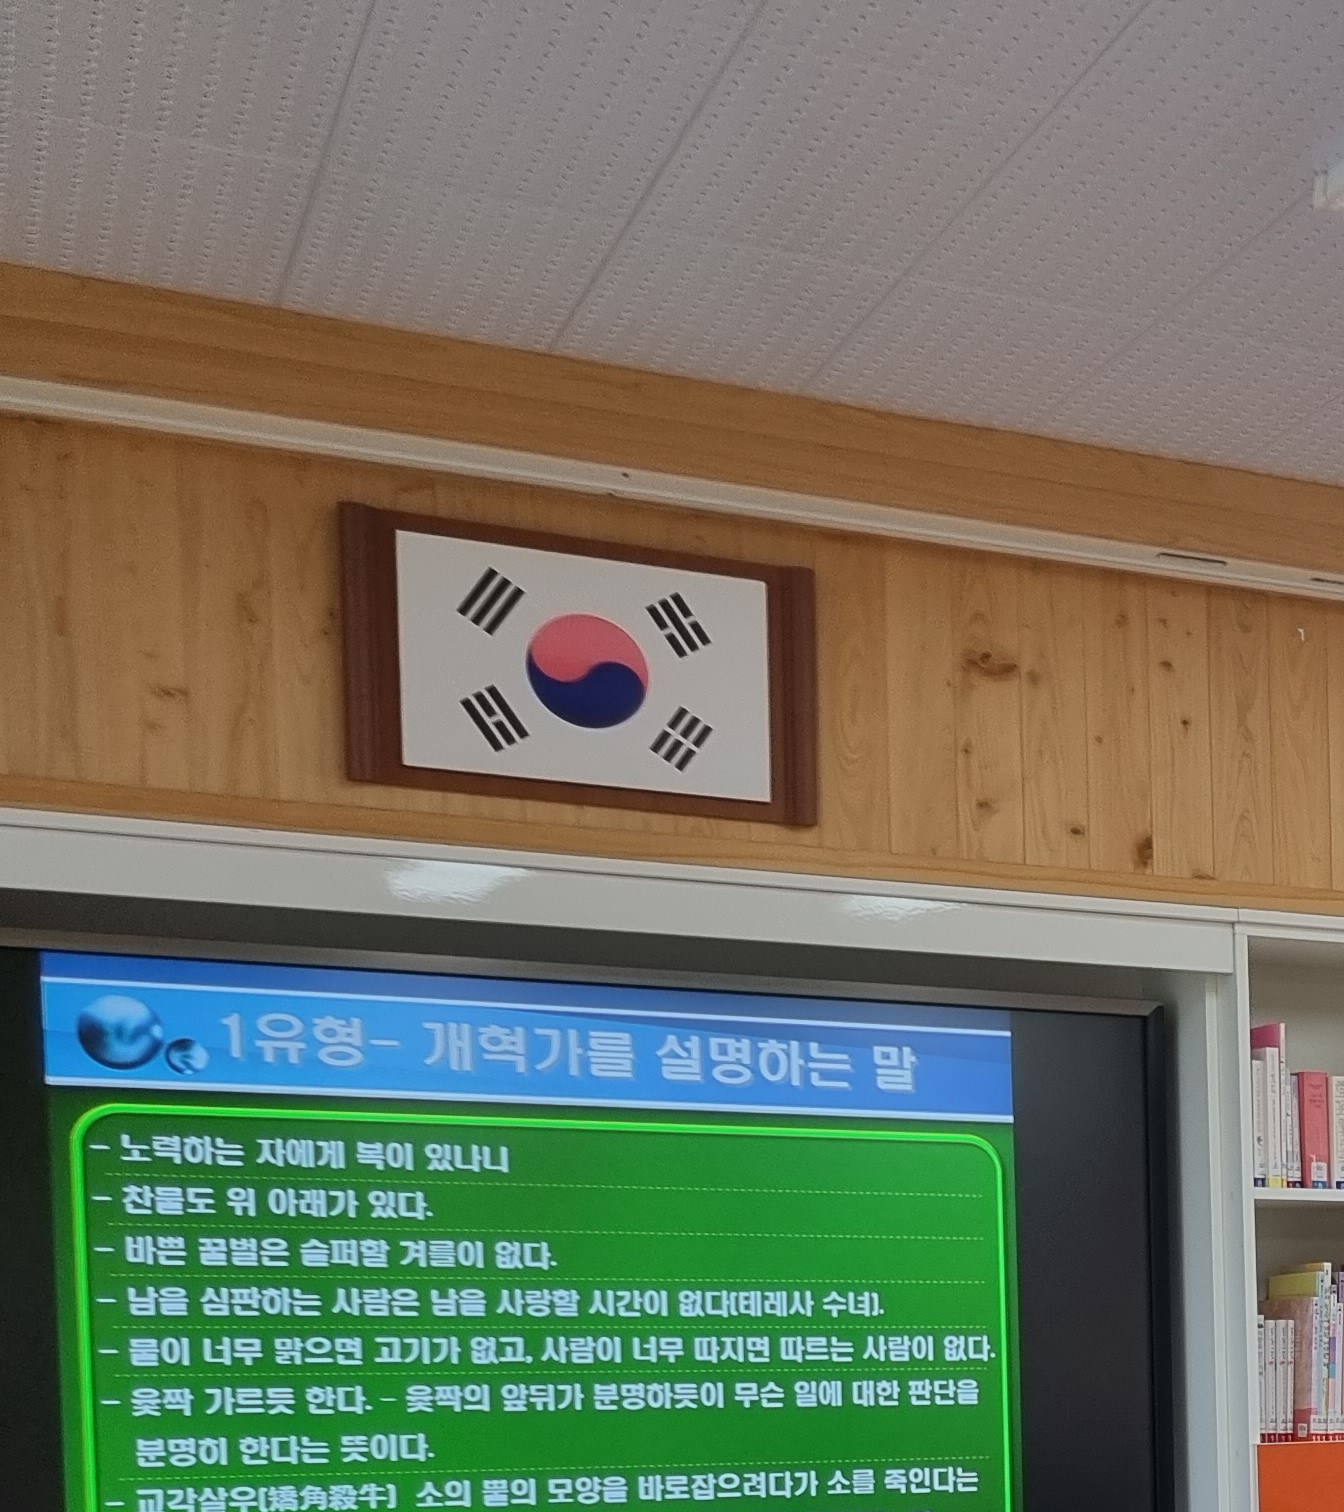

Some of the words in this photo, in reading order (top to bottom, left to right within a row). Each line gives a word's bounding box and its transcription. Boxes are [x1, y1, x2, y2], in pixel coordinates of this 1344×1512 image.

[422, 1022, 635, 1078] 개혁가를
[654, 1034, 853, 1088] 설명하는
[871, 1045, 918, 1091] 말
[121, 1134, 244, 1166] 노력하는
[256, 1138, 345, 1168] 자에게
[356, 1142, 413, 1170] 복이
[425, 1144, 508, 1172] 있나니
[122, 1185, 216, 1215] 찬물도
[227, 1188, 256, 1216] 위
[268, 1189, 359, 1217] 아래가
[368, 1191, 433, 1220] 있다.
[125, 1236, 187, 1265] 바쁜
[199, 1238, 289, 1266] 꿀벌은
[300, 1239, 390, 1267] 슬퍼할
[400, 1241, 484, 1268] 겨를이
[495, 1242, 557, 1270] 없다.
[128, 1287, 189, 1315] 남을
[200, 1287, 322, 1316] 심판하는
[332, 1288, 419, 1316] 사람은
[431, 1289, 486, 1316] 남을
[496, 1289, 580, 1317] 사랑할
[589, 1290, 668, 1316] 시간이
[129, 1338, 189, 1366] 물이
[203, 1337, 263, 1365] 너무
[275, 1337, 362, 1365] 맑으면
[374, 1337, 461, 1364] 고기가
[471, 1337, 532, 1364] 없고,
[541, 1336, 621, 1363] 사람이
[633, 1336, 684, 1363] 너무
[694, 1337, 770, 1363] 따지면
[780, 1336, 854, 1362] 따르는
[863, 1335, 933, 1361] 사람이
[944, 1335, 995, 1361] 없다.
[205, 1387, 295, 1415] 가르듯
[306, 1386, 372, 1414] 한다.
[501, 1384, 584, 1411] 앞뒤가
[594, 1383, 724, 1410] 분명하듯이
[735, 1382, 784, 1408] 무슨
[794, 1381, 842, 1407] 일에
[853, 1380, 900, 1406] 대한
[909, 1379, 979, 1405] 판단을
[136, 1438, 227, 1467] 분명히
[240, 1436, 330, 1464] 한다는
[341, 1433, 434, 1462] 뜻이다.
[417, 1480, 471, 1507] 소의
[548, 1477, 628, 1504] 모양을
[639, 1471, 818, 1501] 바로잡으려다가
[828, 1469, 875, 1494] 소를
[884, 1467, 978, 1493] 죽인다는
